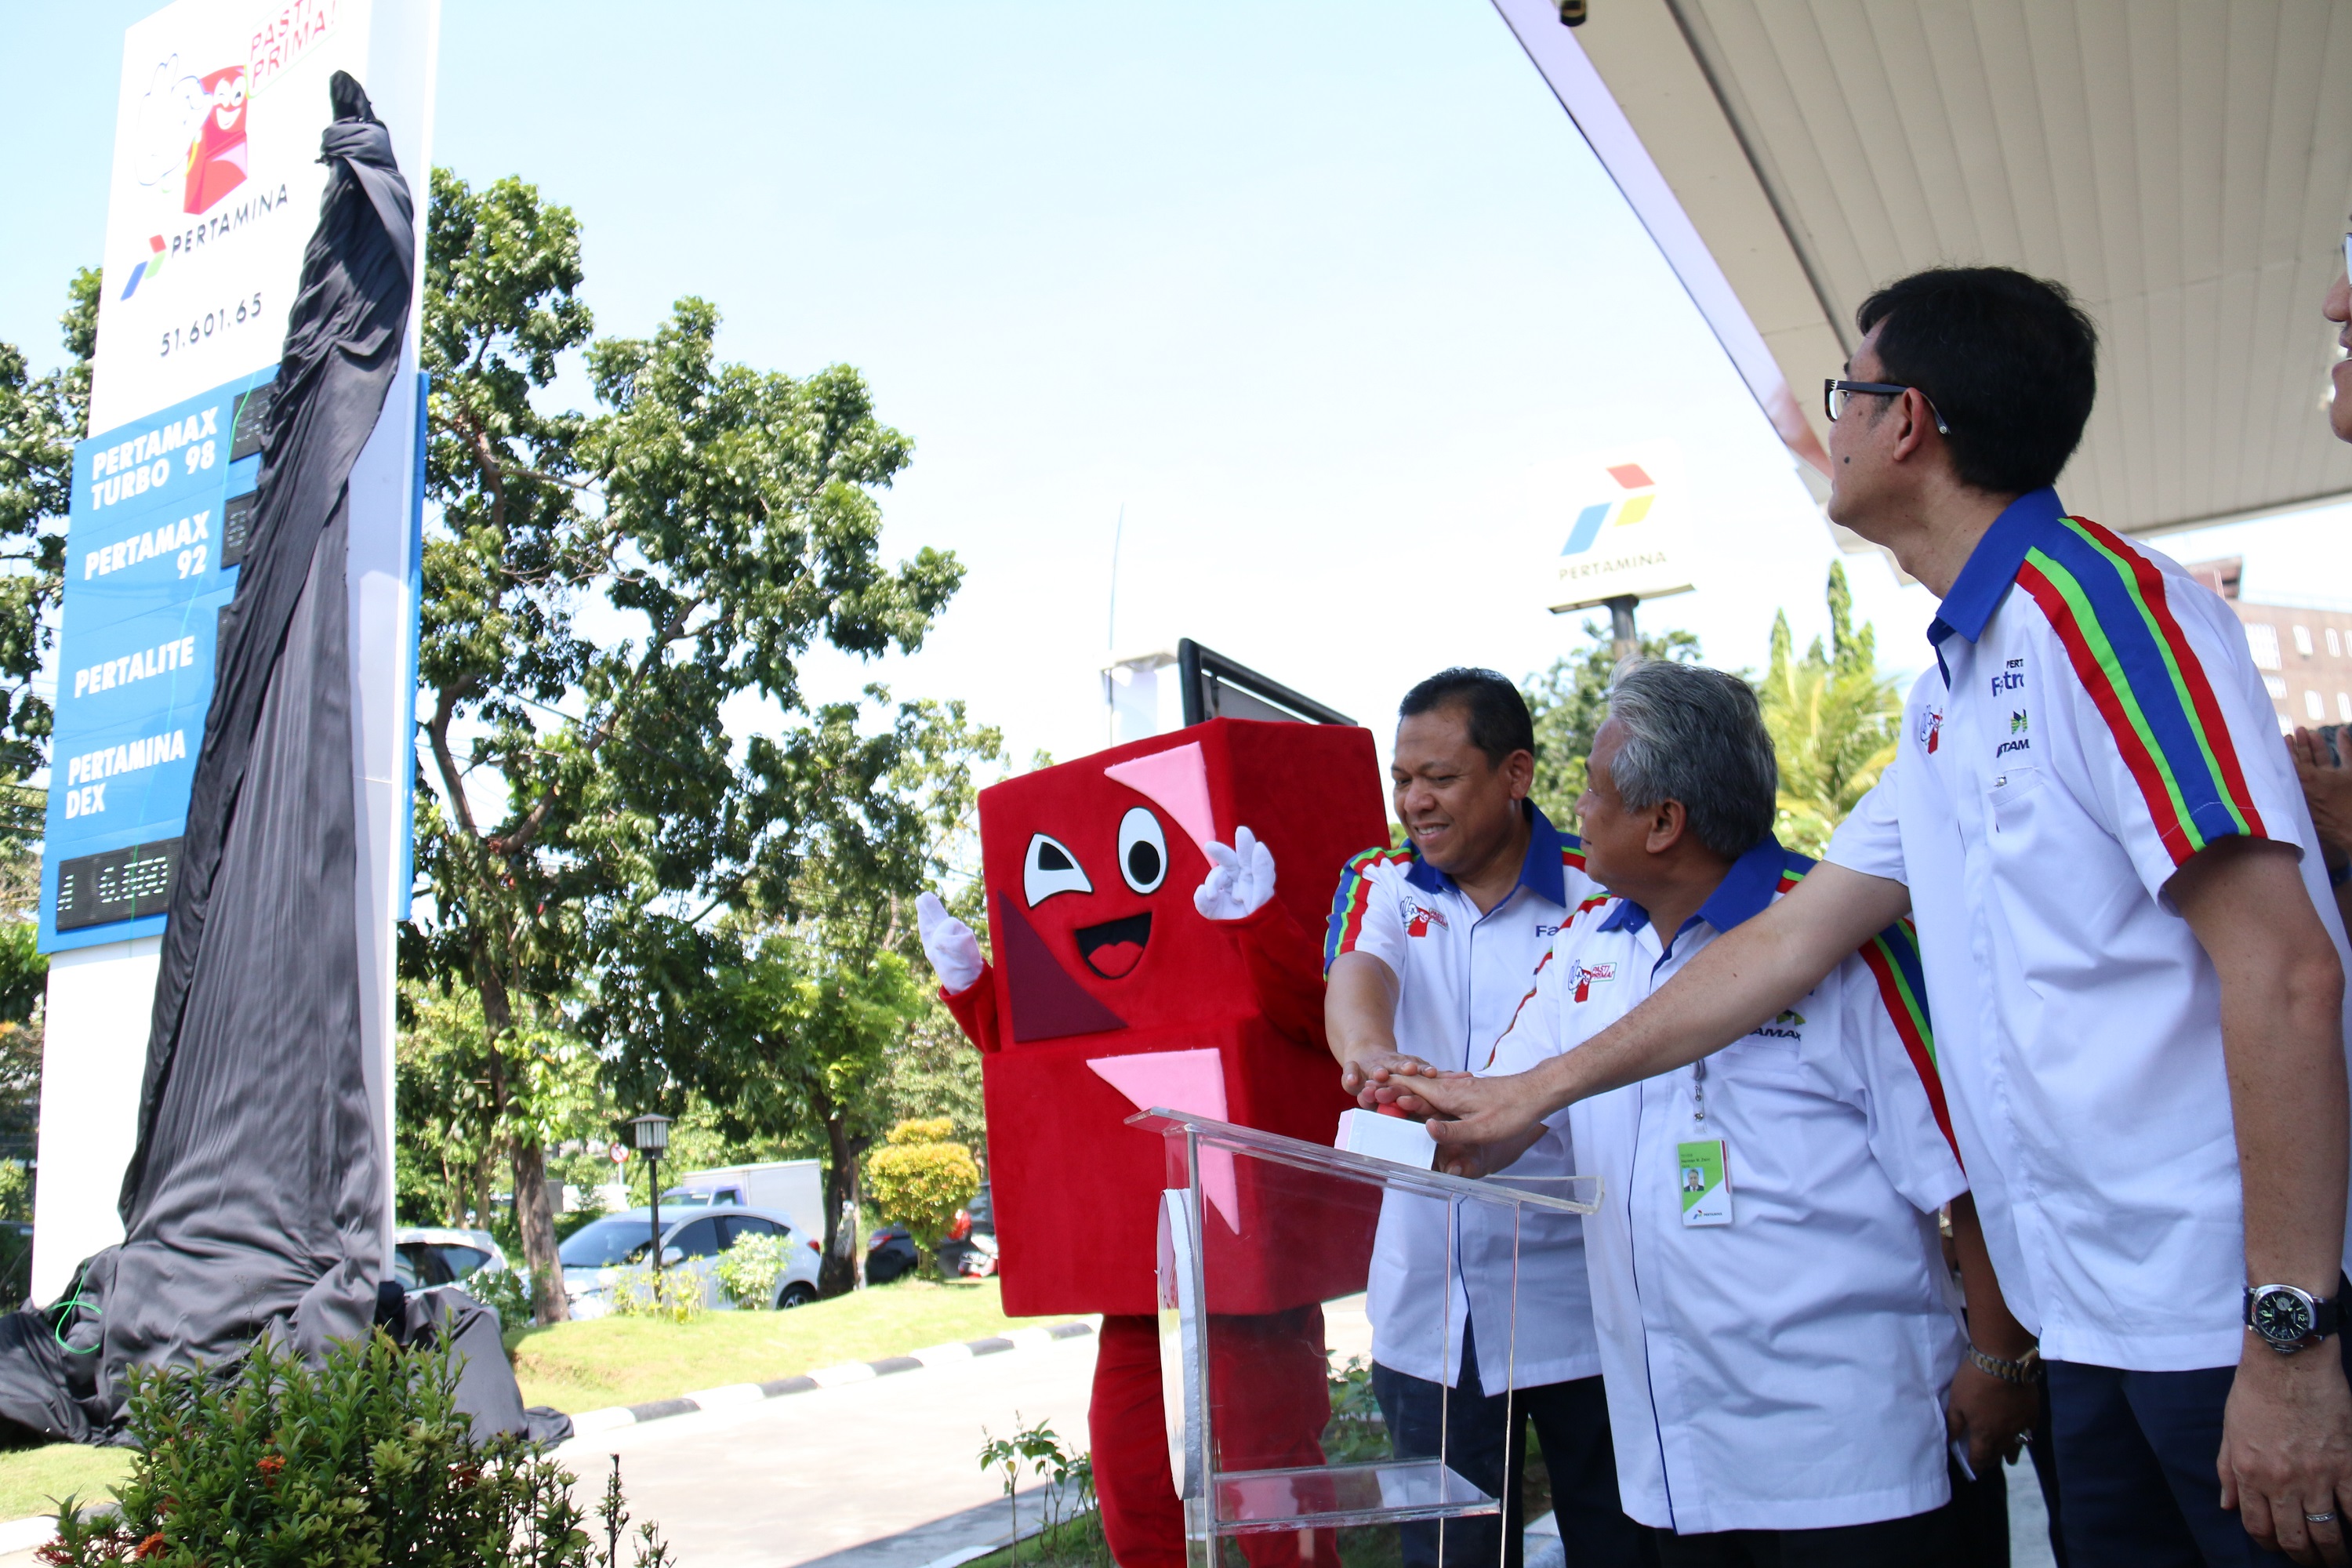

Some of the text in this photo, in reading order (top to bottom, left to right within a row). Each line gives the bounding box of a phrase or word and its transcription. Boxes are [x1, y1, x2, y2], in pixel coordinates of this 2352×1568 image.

[250, 0, 311, 62] PASTI
[252, 0, 336, 89] PRIMA!
[171, 183, 289, 259] PERTAMINA
[160, 292, 262, 357] 51.601.65
[91, 440, 216, 511] TURBO 98
[92, 406, 219, 481] PERTAMAX
[84, 510, 210, 581] PERTAMAX
[176, 545, 207, 580] 92
[1559, 551, 1667, 580] PERTAMINA
[74, 635, 194, 699] PERTALITE
[67, 729, 186, 786] PERTAMINA
[65, 782, 106, 820] DEX
[1535, 925, 1559, 938] Fa
